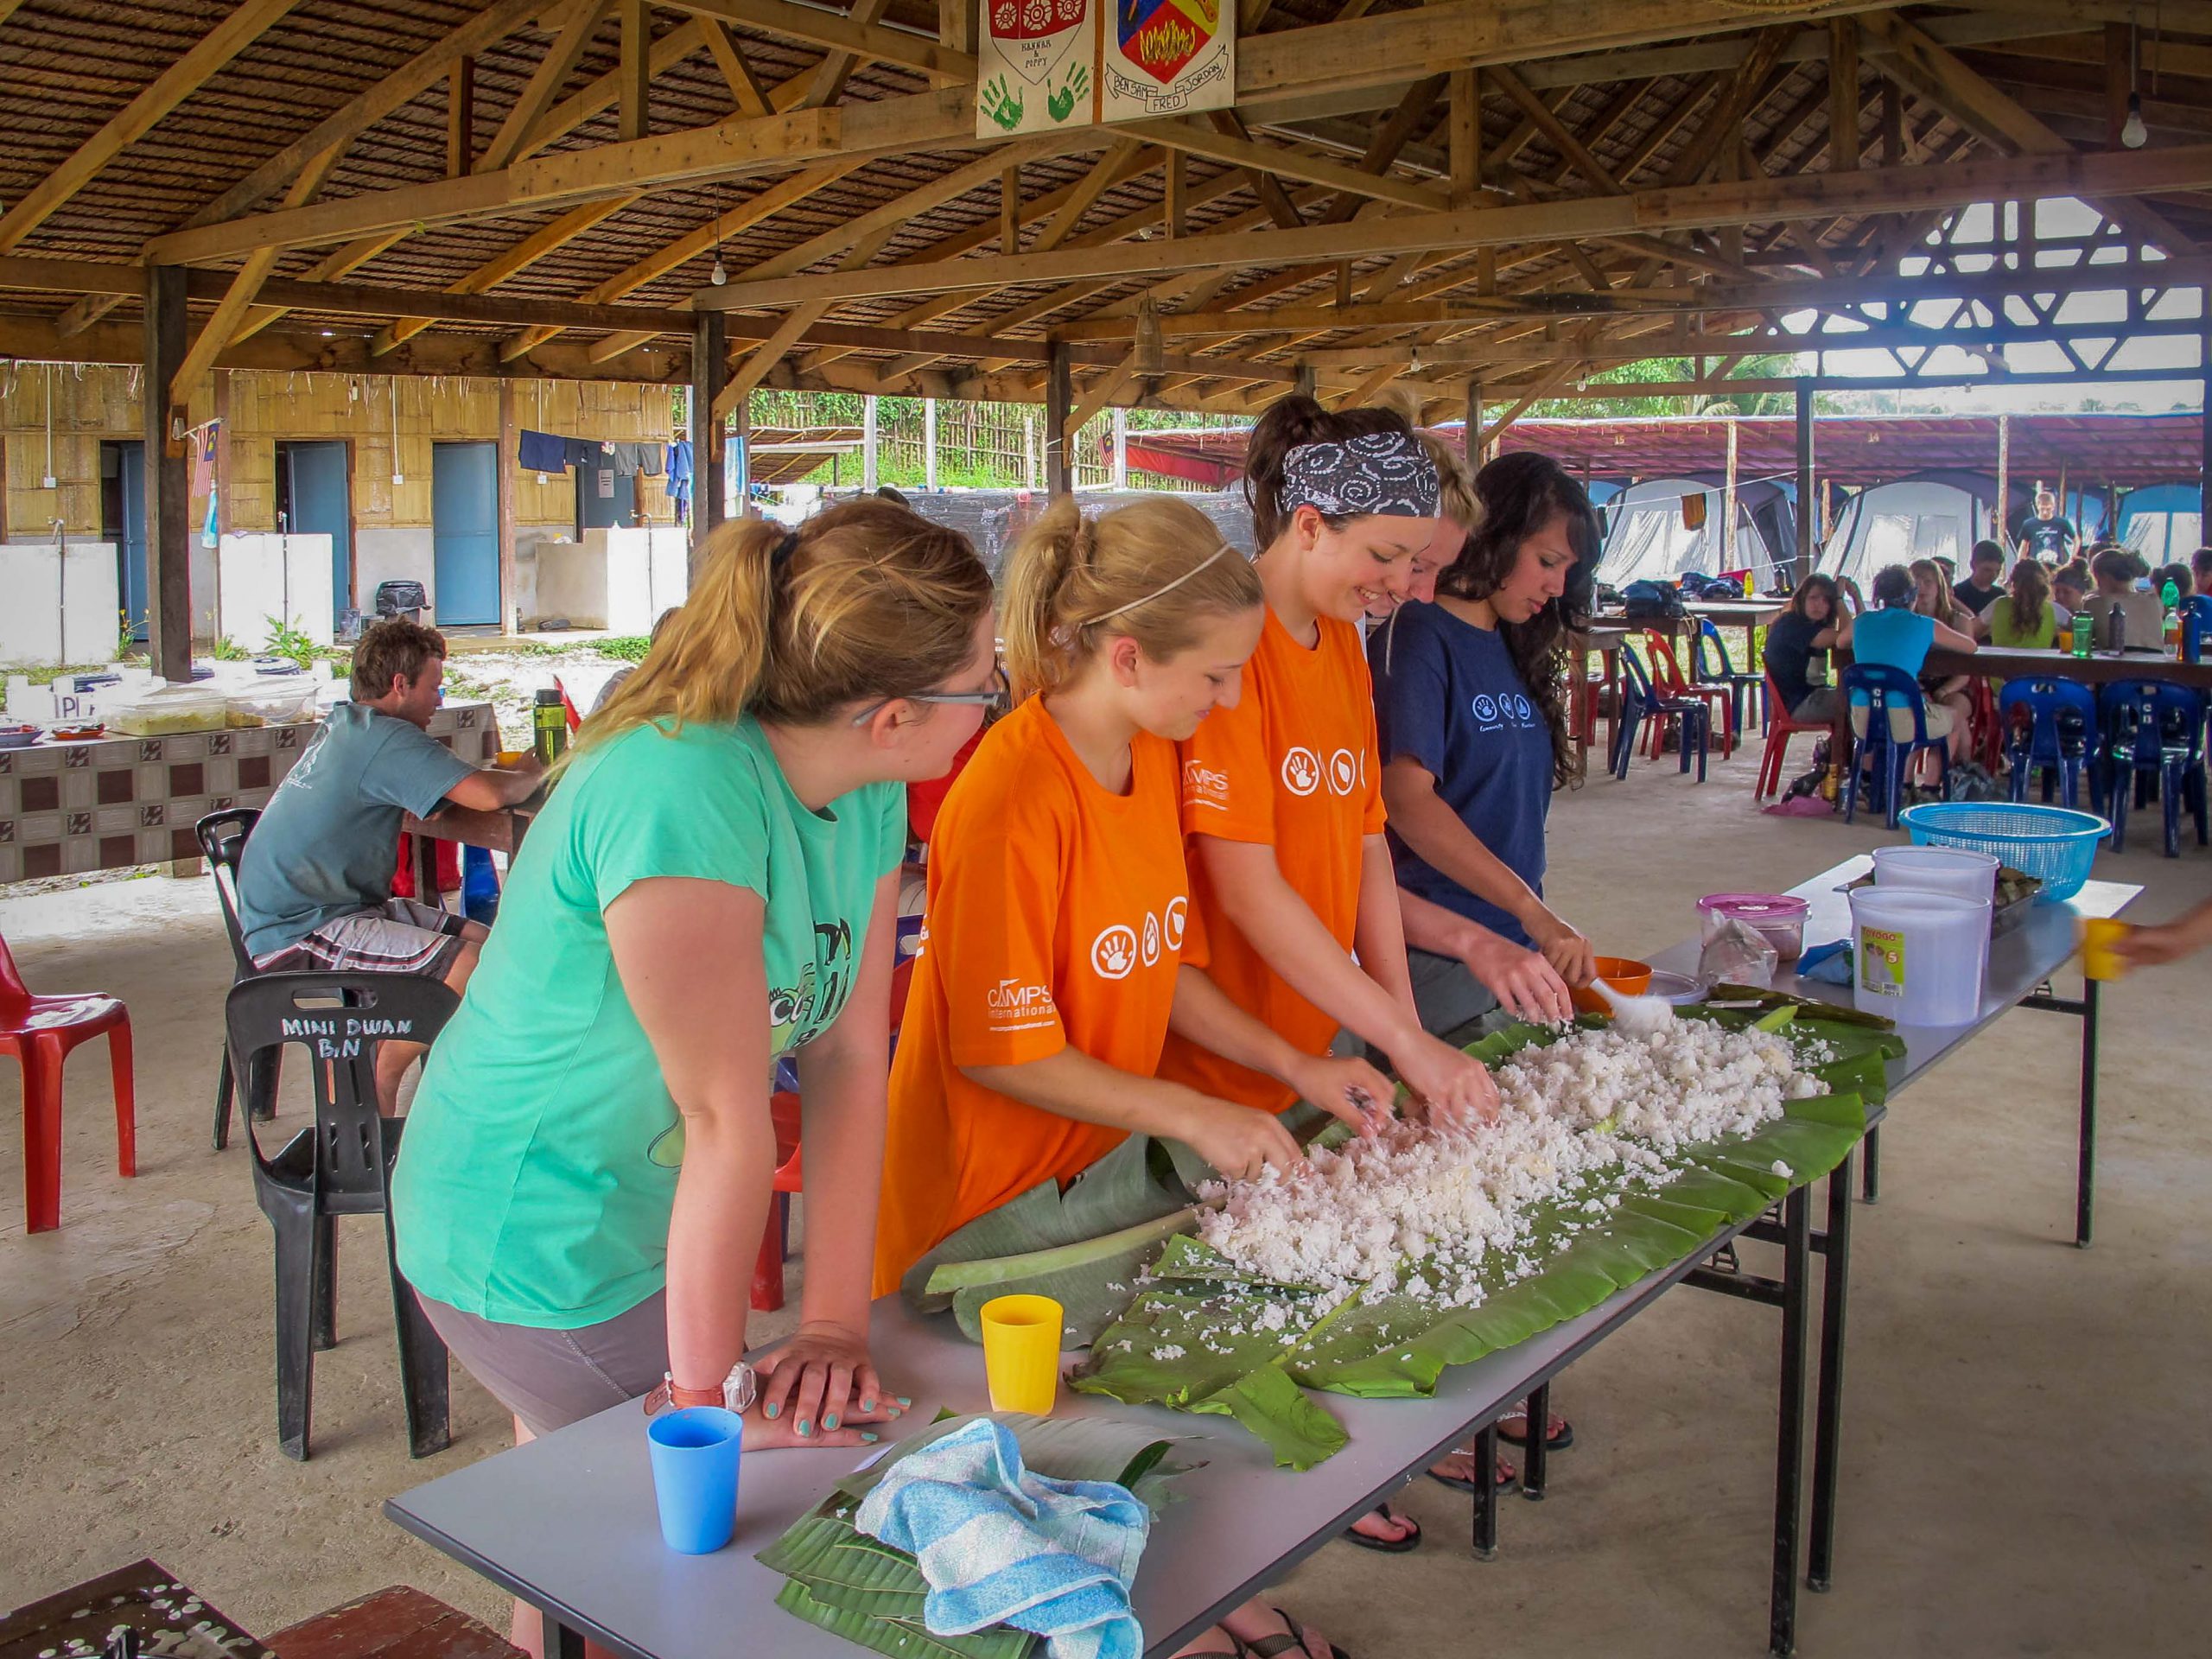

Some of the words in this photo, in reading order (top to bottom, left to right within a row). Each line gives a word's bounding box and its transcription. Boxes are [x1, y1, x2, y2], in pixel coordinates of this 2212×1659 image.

[1021, 40, 1052, 52] HANNAH
[1025, 57, 1047, 68] POPPY
[1114, 75, 1129, 92] BEN
[1130, 83, 1147, 98] SAM
[1185, 63, 1220, 91] JORDAN
[1153, 96, 1180, 111] FRED
[987, 982, 1052, 1007] CAMPS
[282, 1018, 337, 1037] MINI
